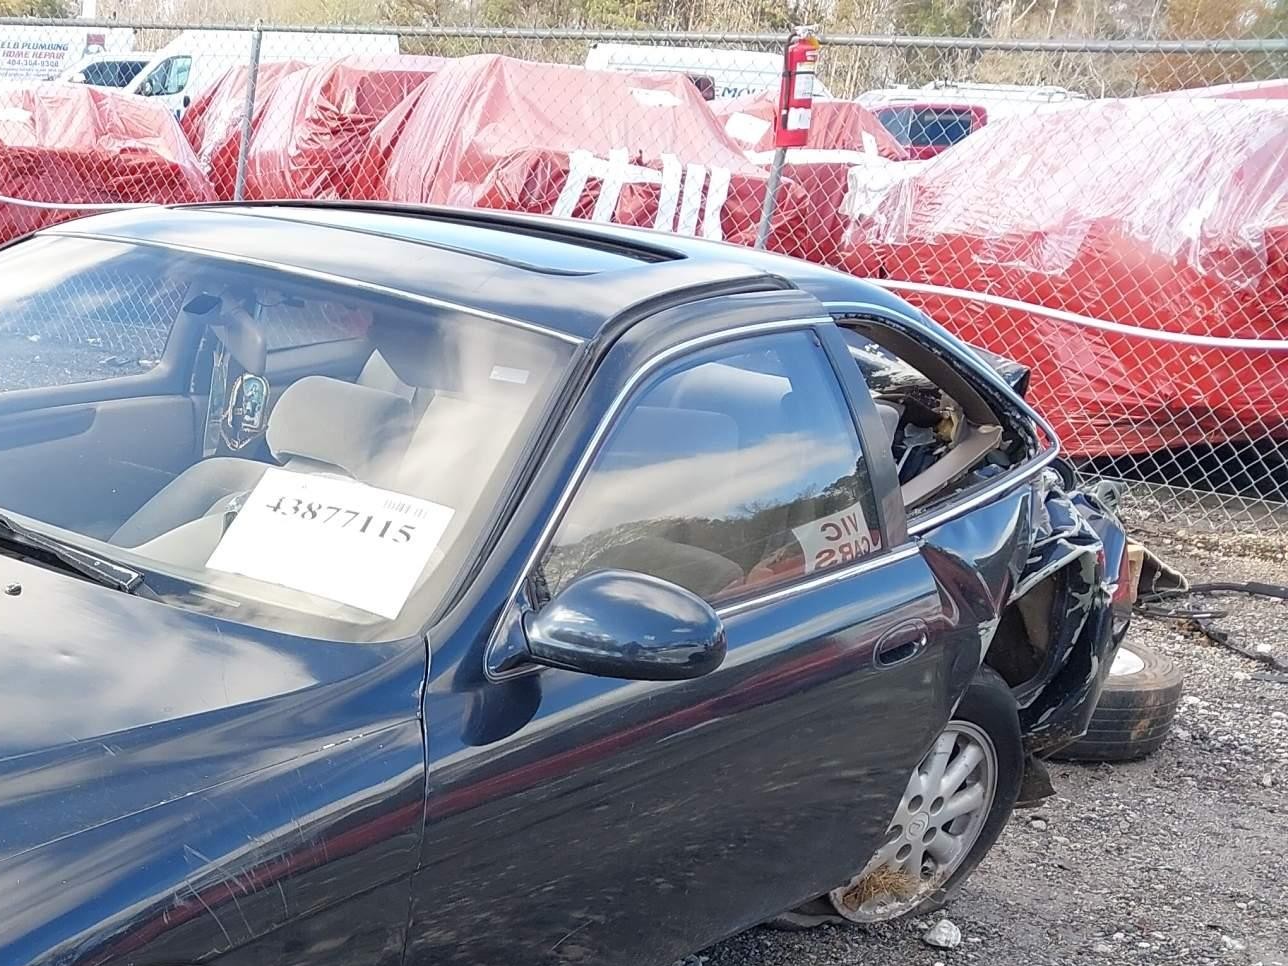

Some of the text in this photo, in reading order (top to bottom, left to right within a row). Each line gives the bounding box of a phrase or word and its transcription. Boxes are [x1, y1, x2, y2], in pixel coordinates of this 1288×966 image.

[2, 49, 66, 60] HOME REPAIR
[265, 496, 416, 543] 43877115
